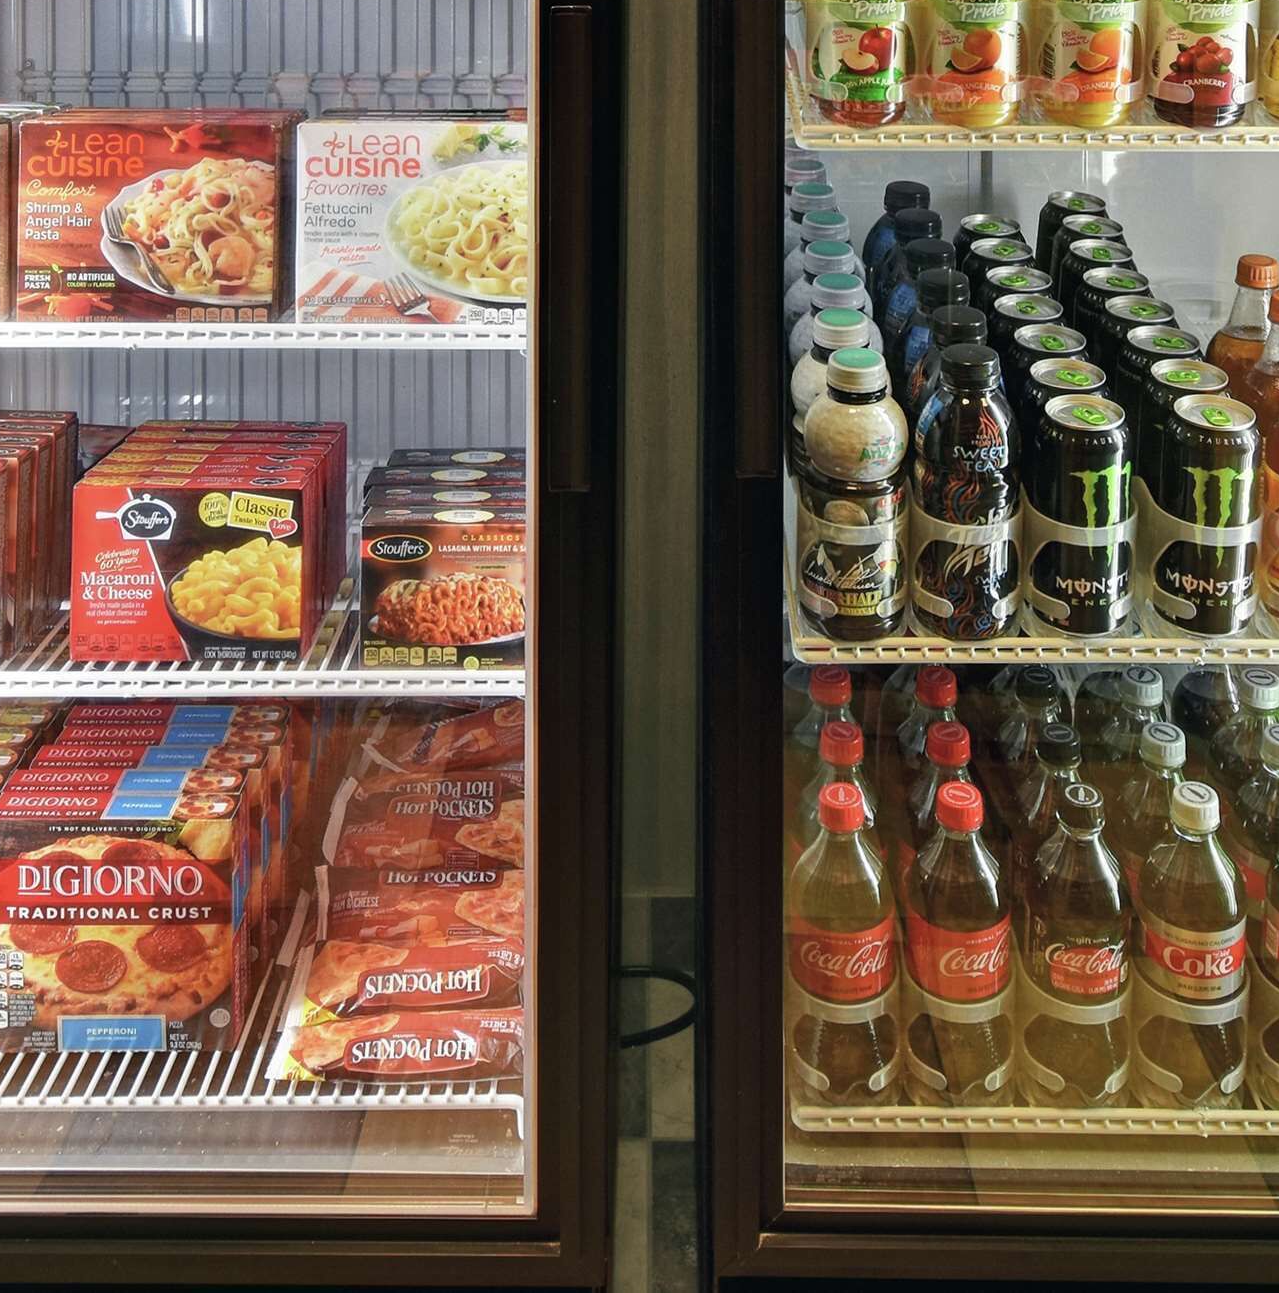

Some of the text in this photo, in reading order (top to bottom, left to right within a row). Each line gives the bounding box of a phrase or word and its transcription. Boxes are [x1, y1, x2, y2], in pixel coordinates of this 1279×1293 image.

[851, 1, 899, 20] Pride
[958, 0, 1007, 20] Pride
[1085, 2, 1128, 21] Pride
[1185, 0, 1233, 21] Pride
[1183, 79, 1228, 89] CRANBERRY
[71, 133, 144, 155] Lean
[349, 134, 420, 155] Lean
[26, 179, 97, 200] Comfort
[301, 180, 387, 201] favorites
[26, 202, 83, 216] Shrimp &
[304, 202, 373, 215] Fettuccini
[25, 215, 93, 229] Angel Hair
[304, 215, 357, 228] Alfredo
[25, 229, 60, 240] Pasta
[24, 274, 51, 282] FRESH
[66, 273, 115, 281] NO ARTIFICIAL
[952, 445, 1006, 458] SWEET
[964, 461, 996, 472] TEA
[235, 497, 287, 518] Classic
[124, 510, 170, 530] Stouffer's
[462, 534, 521, 542] CLASSICS
[375, 541, 425, 558] Stouffer's
[438, 545, 472, 553] LASAGNA
[472, 545, 492, 553] WITH
[492, 545, 511, 553] MEAT
[80, 571, 156, 586] Macaroni
[82, 585, 153, 600] & Cheese
[80, 708, 163, 717] DIGIORNO
[70, 728, 155, 737] DIGIORNO
[47, 748, 134, 758] DIGIORNO
[20, 772, 110, 783] DIGIORNO
[6, 796, 99, 807] DIGIORNO
[17, 865, 203, 896] DIGIORNO
[424, 870, 497, 884] POCKETS
[6, 906, 212, 920] TRADITIONAL CRUST
[800, 934, 890, 979] Coca-Cola
[1045, 939, 1127, 975] Coca-Cola
[1163, 946, 1234, 977] Coke
[365, 969, 482, 998] HOT POCKETS
[479, 1020, 508, 1029] CHEESE
[351, 1038, 473, 1063] HOT POCKETS
